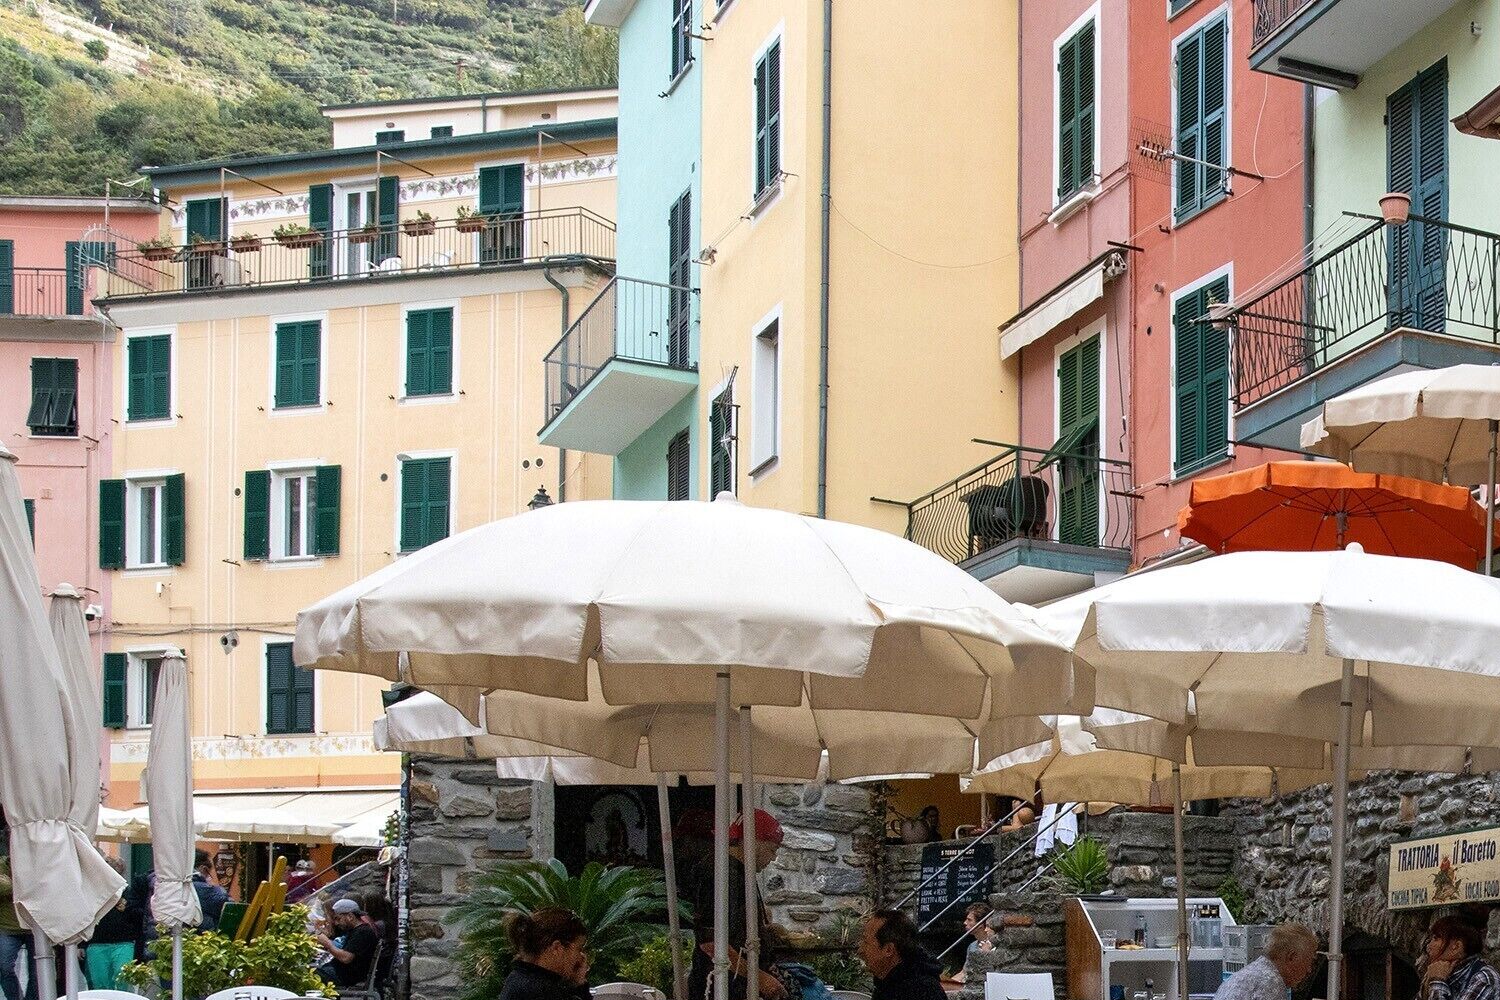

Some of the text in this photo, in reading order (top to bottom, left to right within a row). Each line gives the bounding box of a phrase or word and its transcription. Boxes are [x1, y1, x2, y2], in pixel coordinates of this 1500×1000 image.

[1398, 839, 1496, 872] TRATTORIA il Baretto
[1411, 887, 1428, 905] TIPICA
[1465, 882, 1482, 899] LOCAL
[1484, 880, 1500, 897] FOOD
